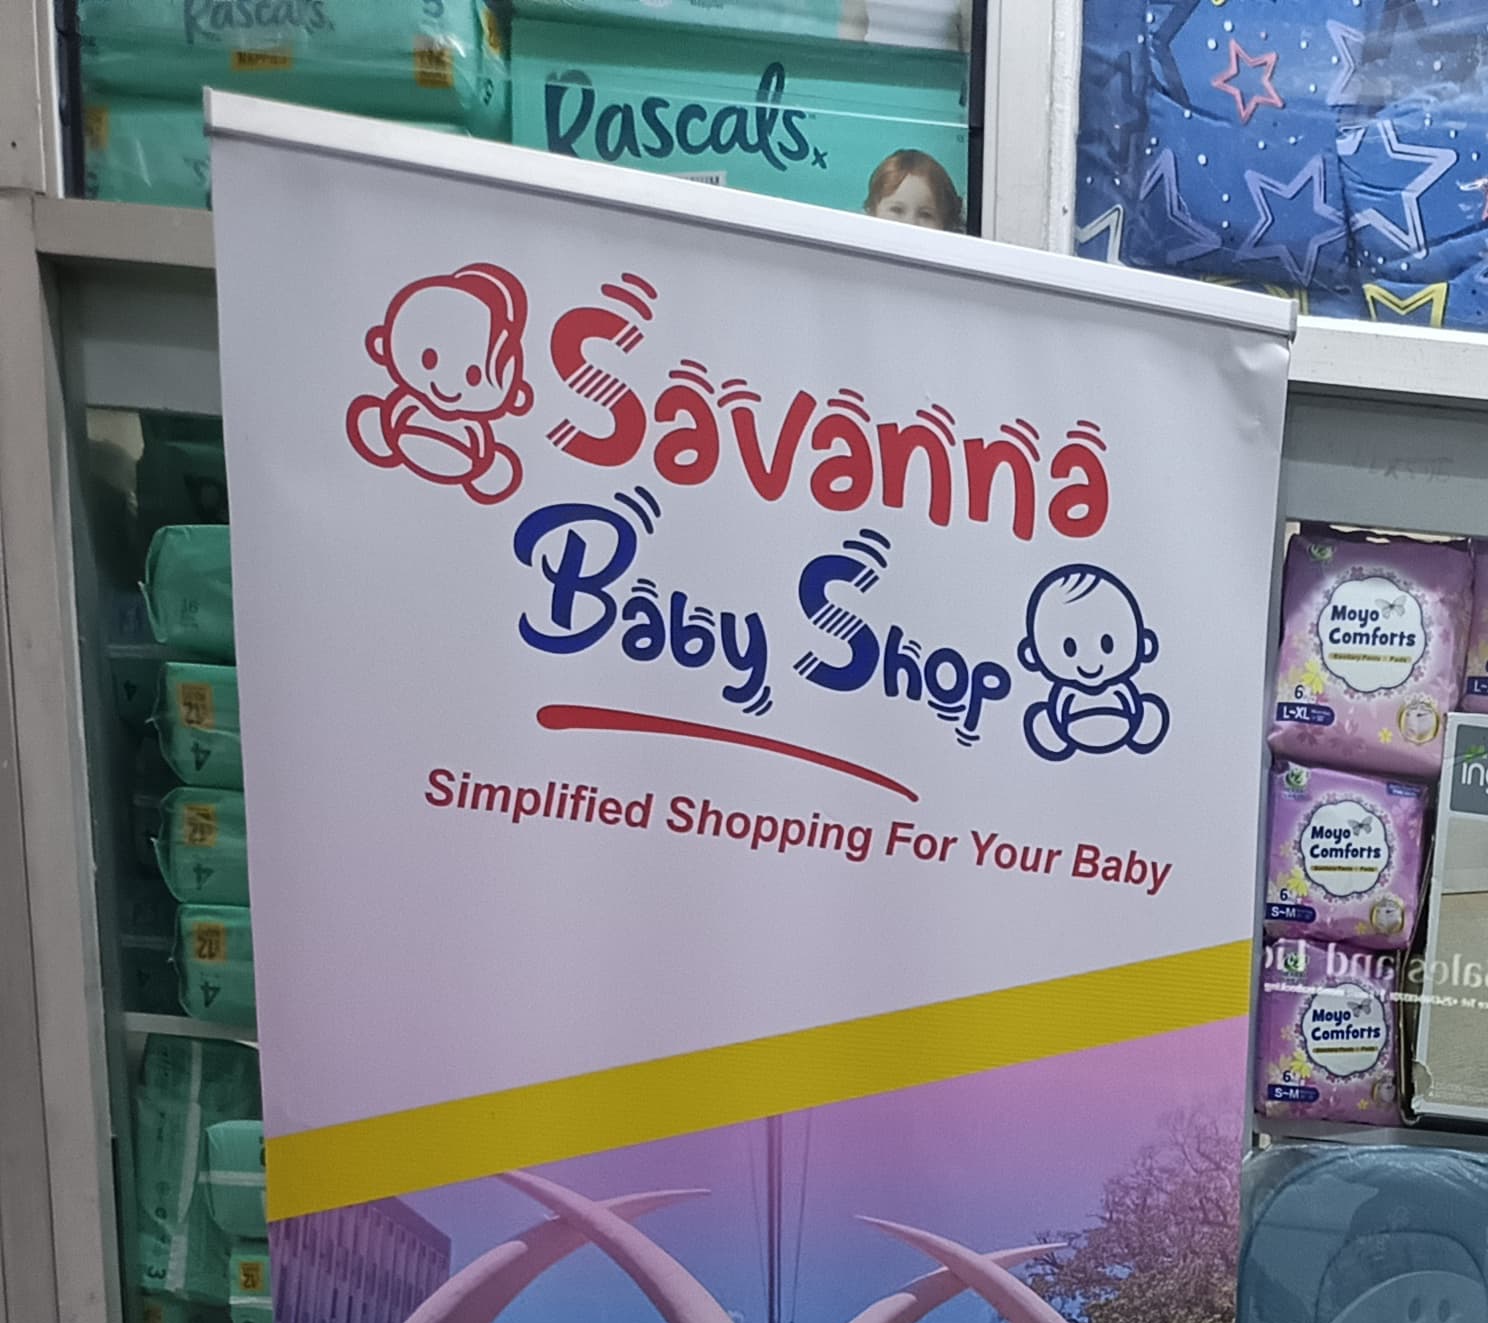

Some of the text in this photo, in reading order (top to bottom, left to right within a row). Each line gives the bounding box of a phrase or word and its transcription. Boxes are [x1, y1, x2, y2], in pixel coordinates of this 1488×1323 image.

[546, 300, 1110, 541] Savanna
[513, 498, 1012, 735] Baby Shop
[1331, 605, 1379, 628] Moyo
[1329, 627, 1416, 646] Comforts
[424, 768, 1173, 895] Simplified Shopping For Your Baby
[1311, 825, 1351, 844] Moyo
[1309, 843, 1381, 860] Comforts
[1312, 1008, 1352, 1027] Moyo
[1311, 1024, 1381, 1042] Comforts
